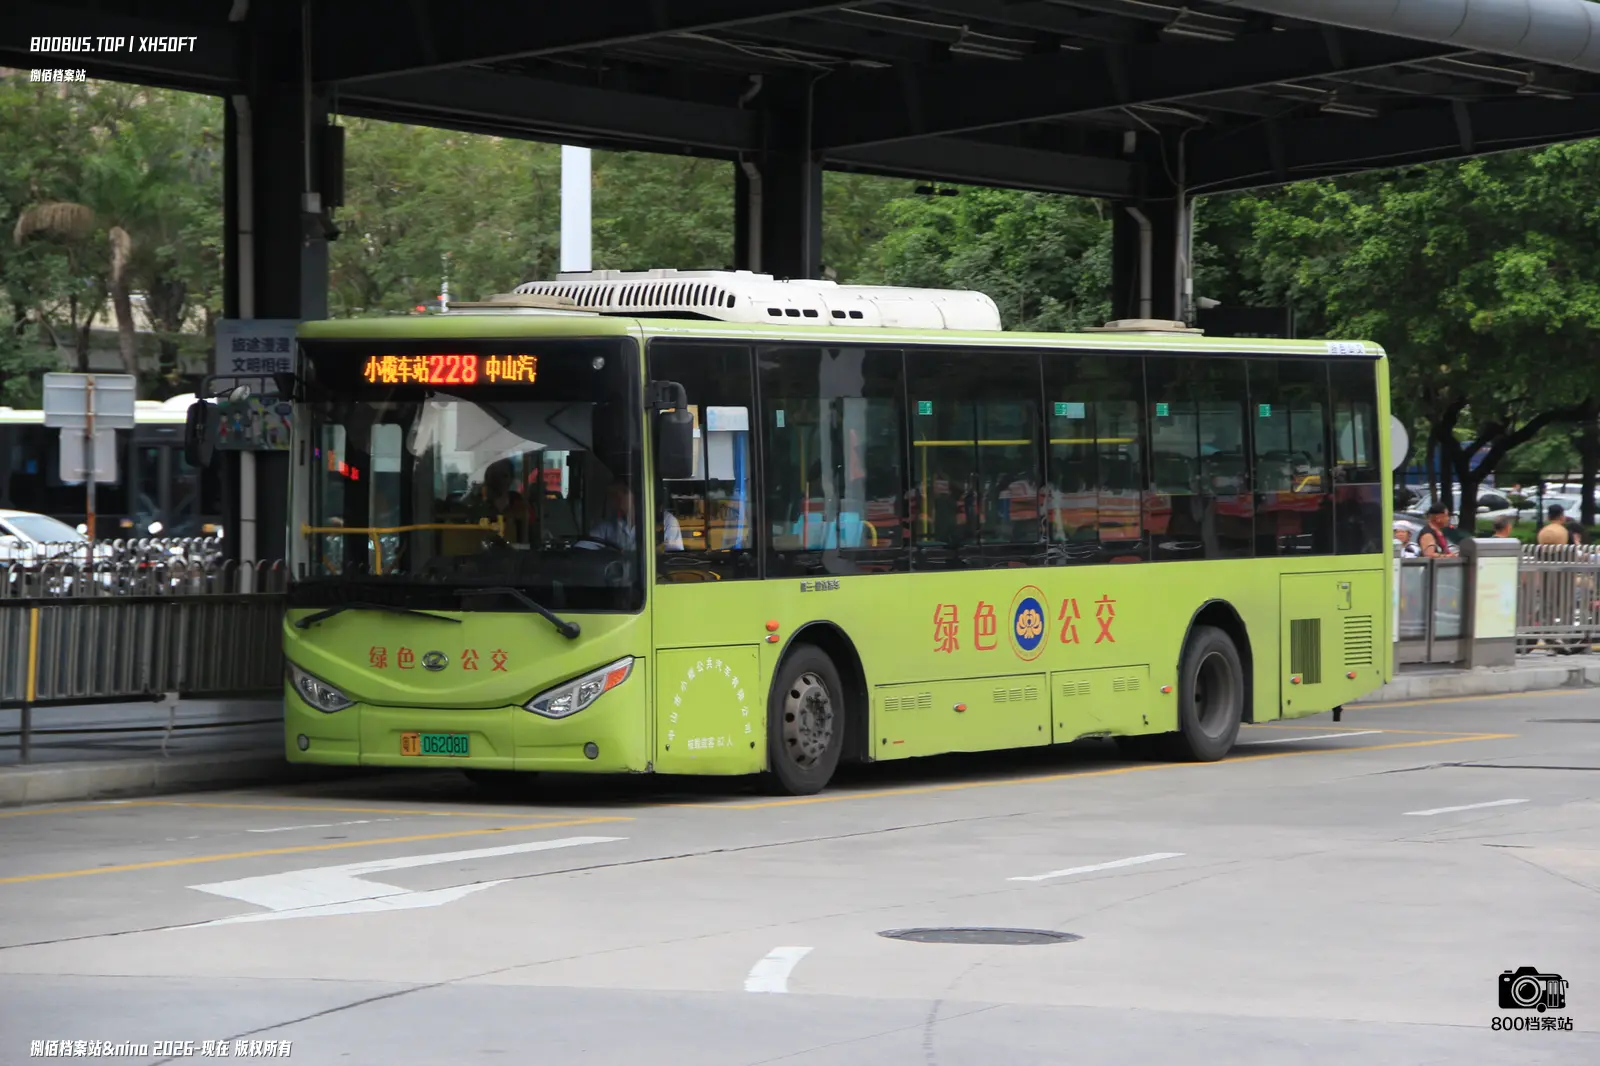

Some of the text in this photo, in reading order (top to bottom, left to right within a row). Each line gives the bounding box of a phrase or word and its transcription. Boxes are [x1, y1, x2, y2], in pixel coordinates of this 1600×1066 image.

[430, 355, 478, 384] 228
[485, 355, 538, 383] 中山汽
[933, 594, 1117, 654] 绿色 公交
[369, 646, 509, 672] 绿色 公交
